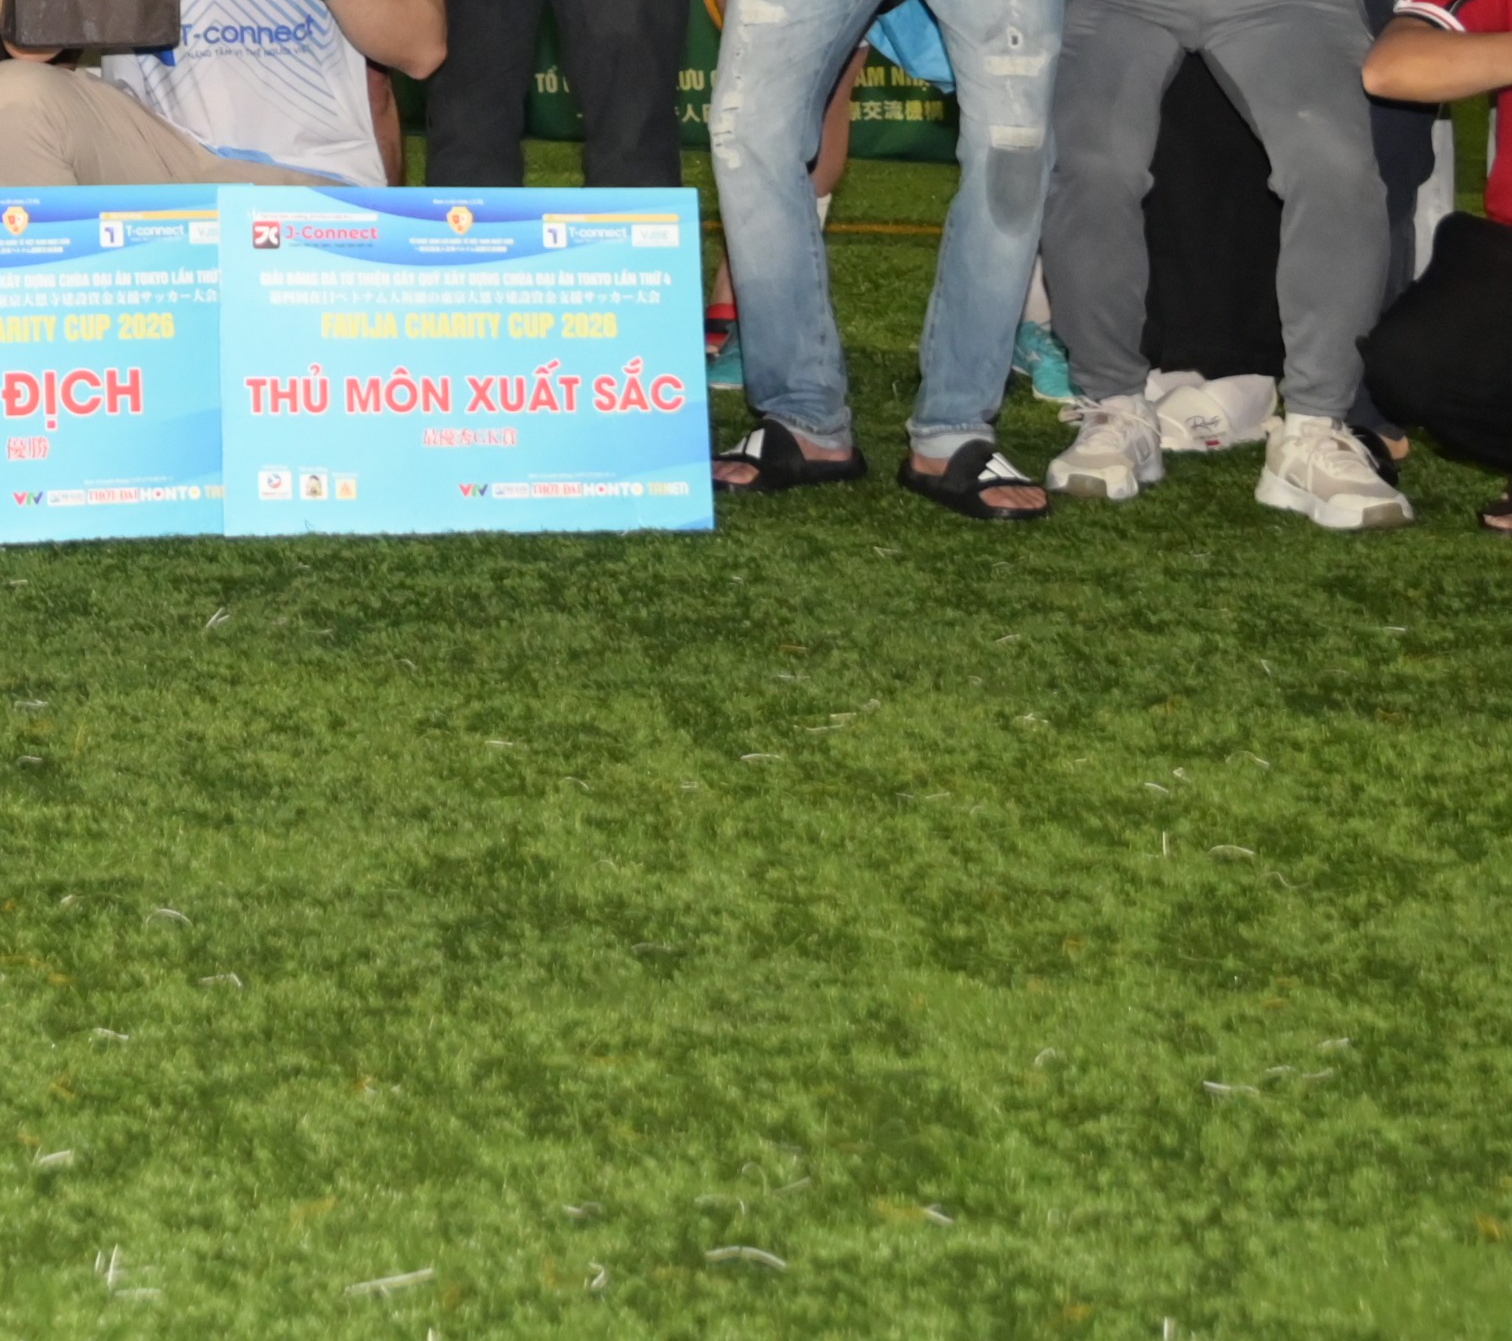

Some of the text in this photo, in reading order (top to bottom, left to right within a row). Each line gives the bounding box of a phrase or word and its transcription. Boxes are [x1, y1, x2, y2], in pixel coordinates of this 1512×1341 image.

[284, 225, 378, 241] J-Connect
[64, 314, 111, 342] CUP
[117, 311, 175, 340] 2026
[244, 356, 686, 415] THỦ MÔN XUẤT SẮC
